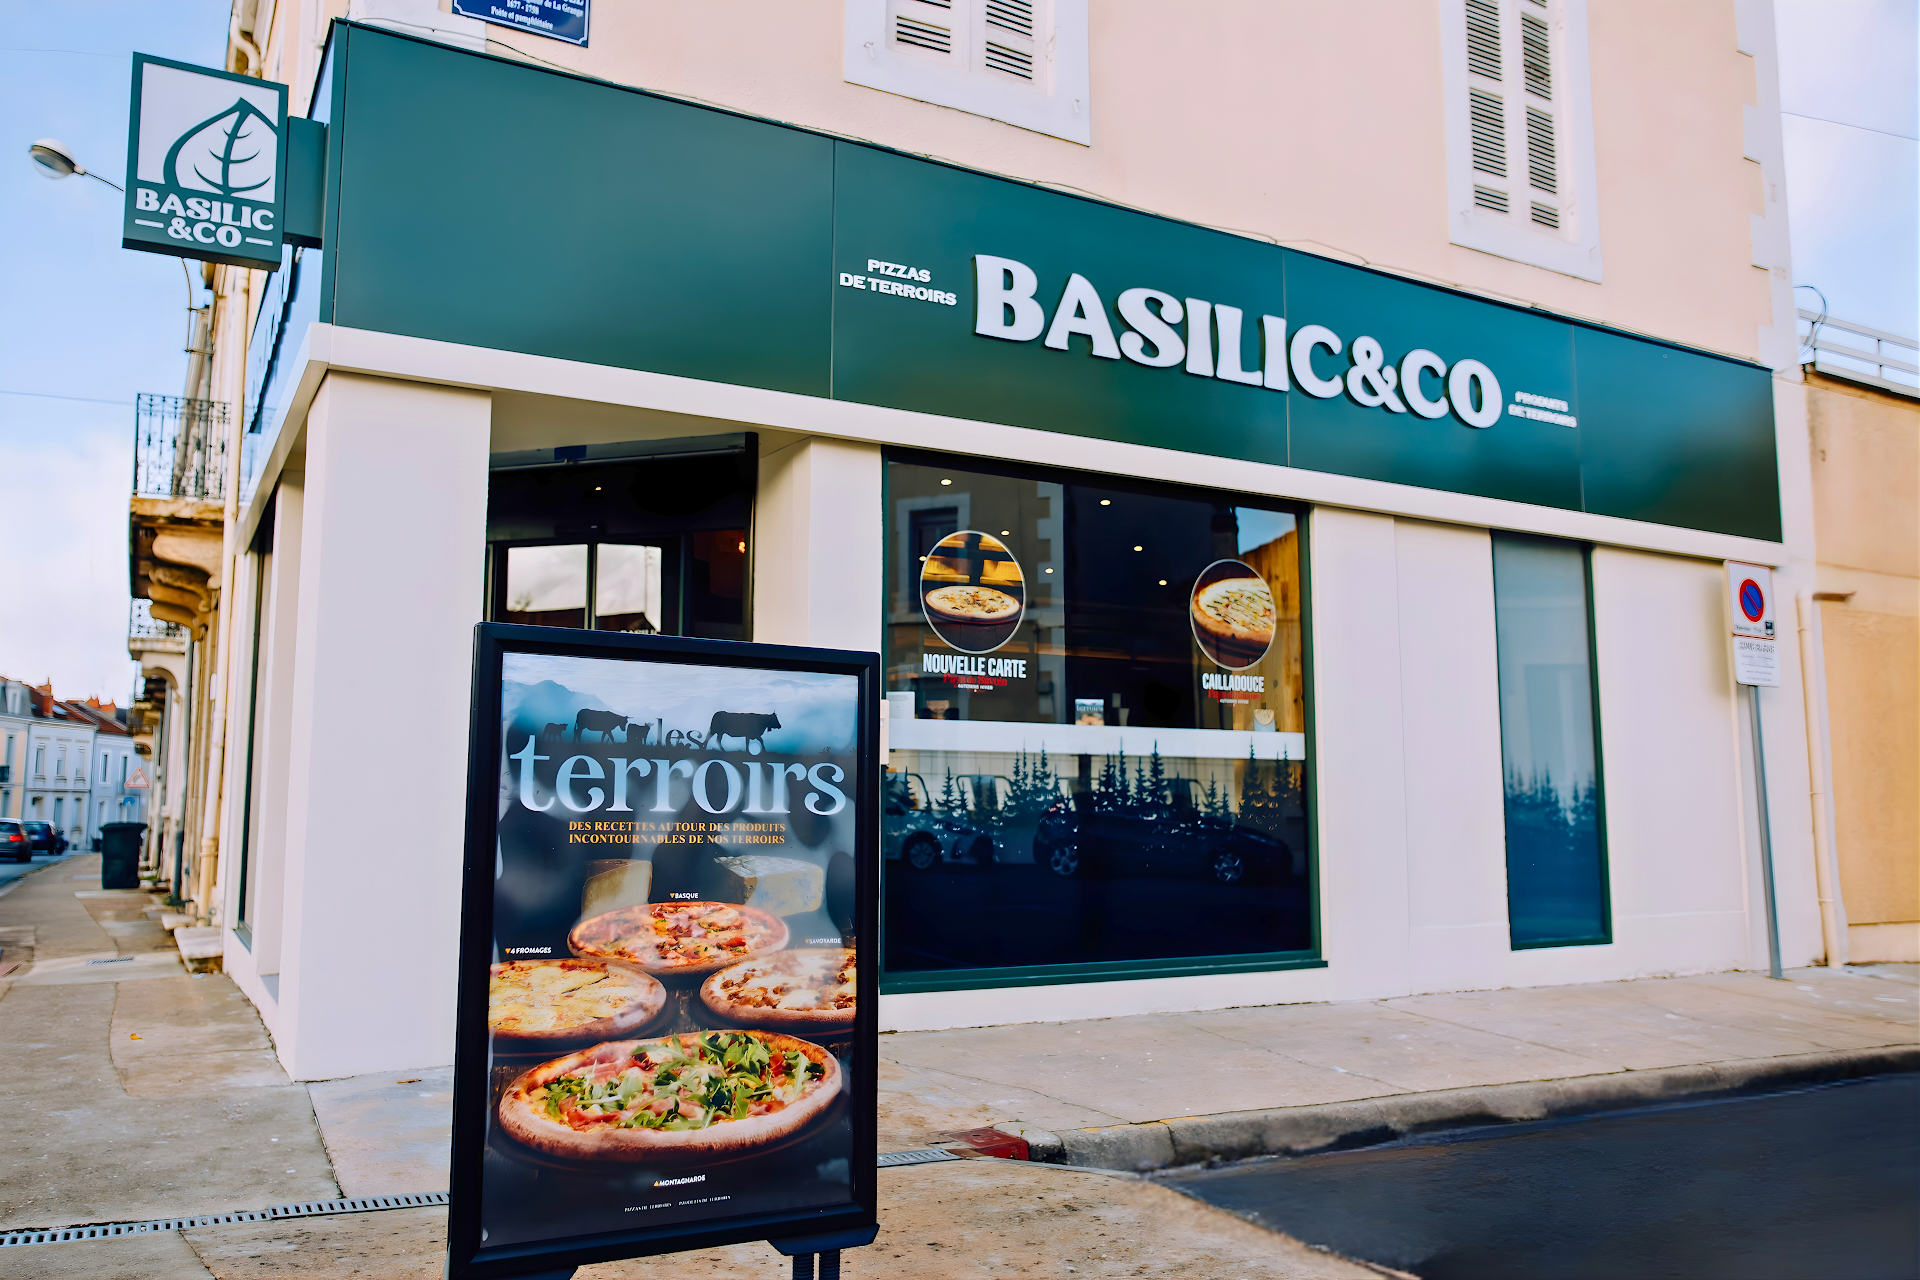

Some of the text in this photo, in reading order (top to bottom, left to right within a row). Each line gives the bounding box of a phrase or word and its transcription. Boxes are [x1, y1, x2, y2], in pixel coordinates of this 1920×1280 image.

[135, 187, 274, 231] BASILIC
[167, 216, 242, 248] &CO
[867, 258, 931, 283] PIZZAS
[839, 272, 957, 306] DE TERROIRS
[974, 254, 1503, 429] BASILIC&CO
[922, 653, 1027, 679] NOUVELLE CARTE
[1202, 672, 1265, 693] CAILLADOUCE
[655, 717, 704, 751] les
[509, 734, 847, 816] terroirs
[568, 821, 786, 832] DES RECETTES AUTOUR DES PRODUITS
[568, 834, 786, 844] INCONTOURNABLES DE NOS TERROIRS
[510, 946, 552, 955] 4 FROMAGES
